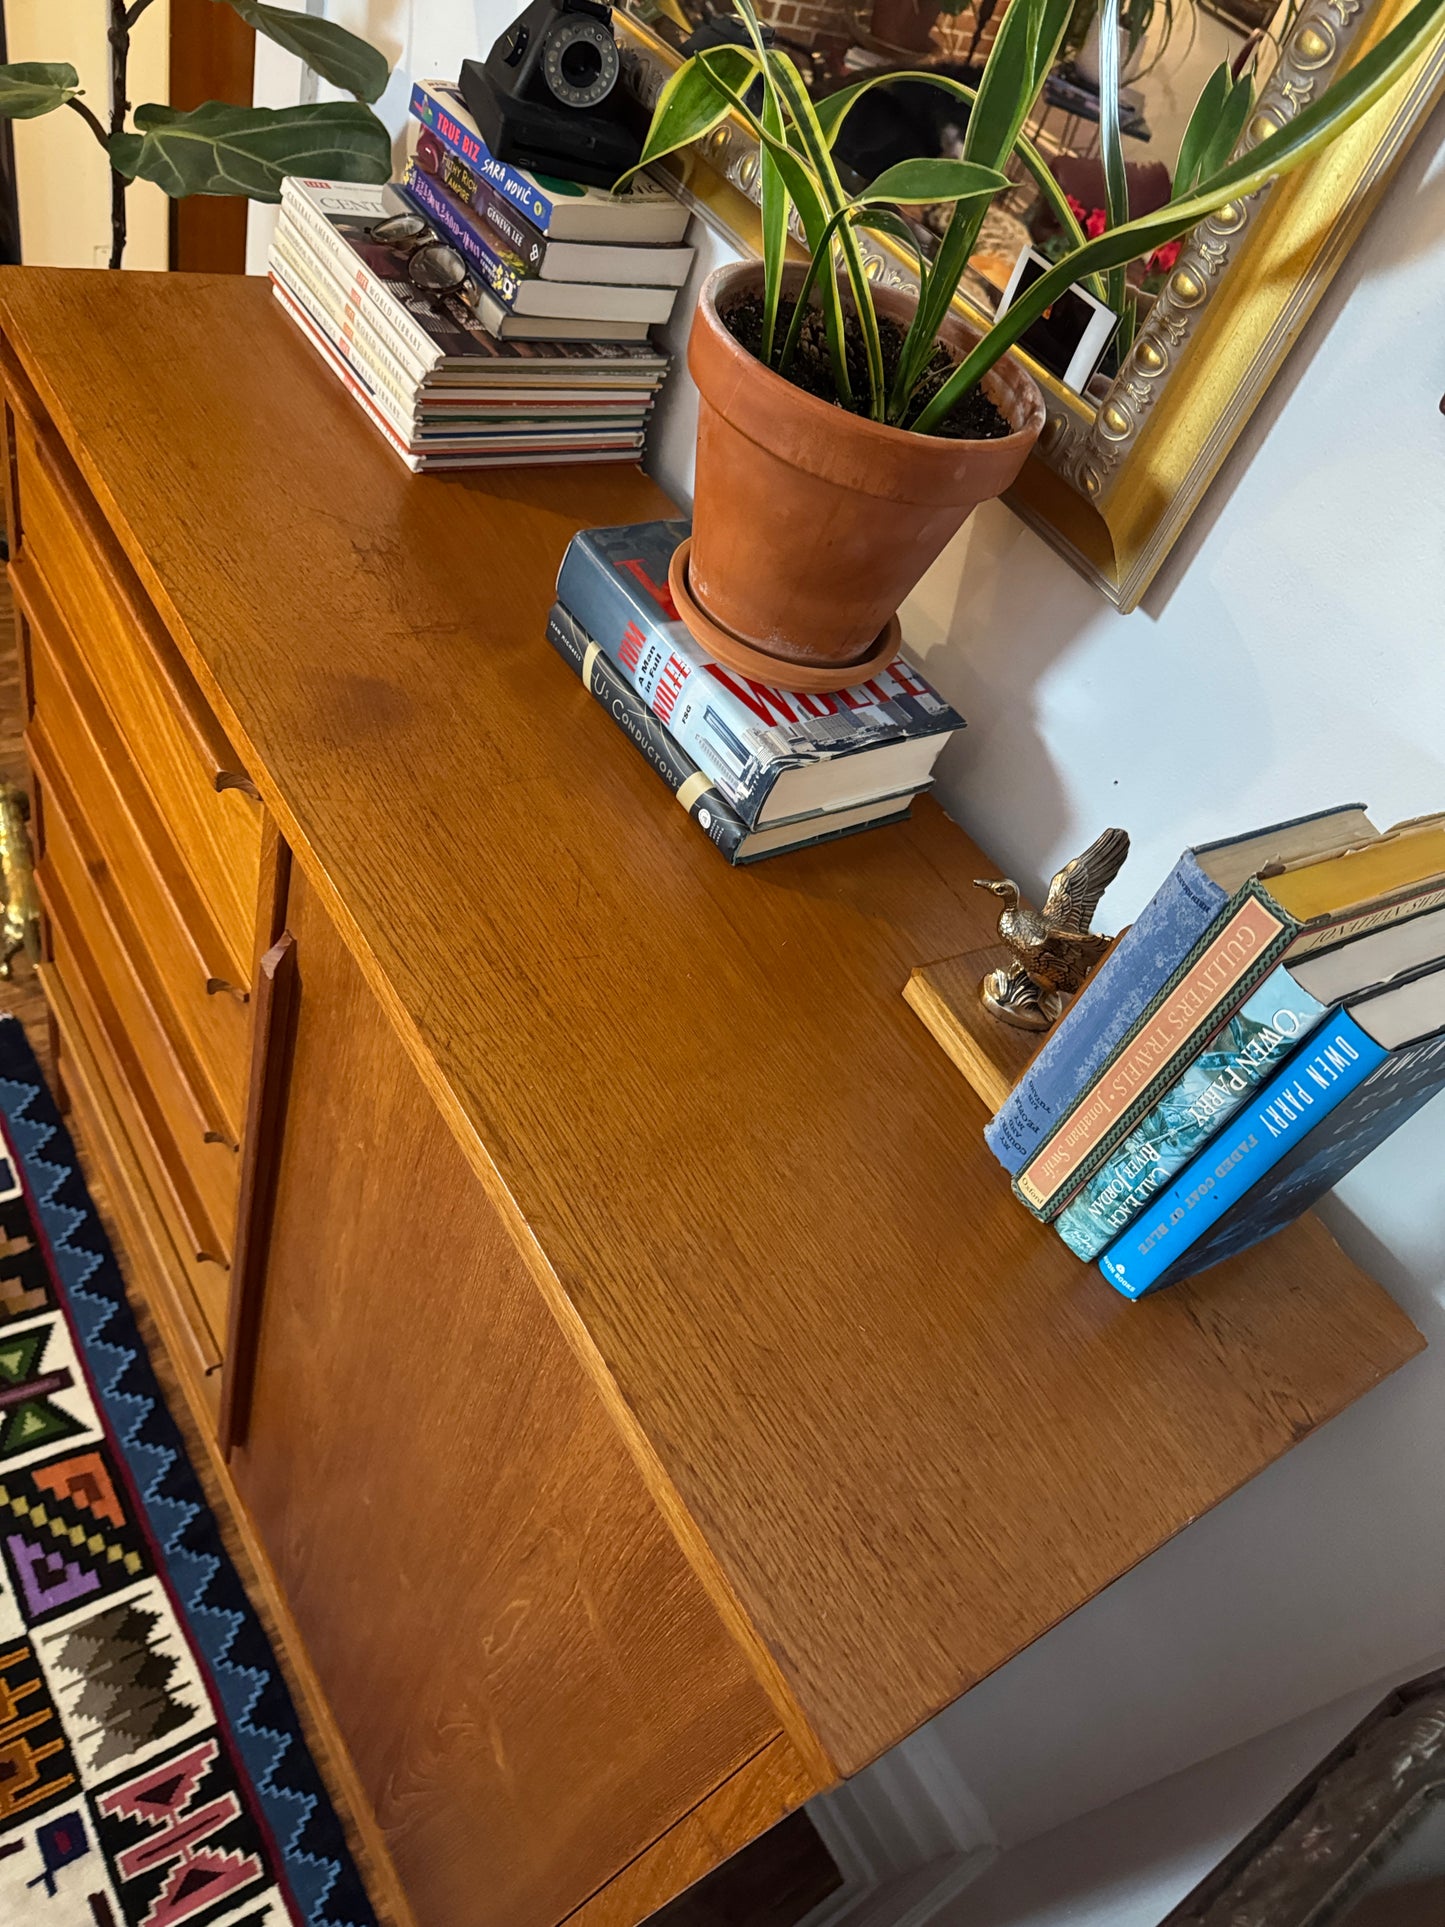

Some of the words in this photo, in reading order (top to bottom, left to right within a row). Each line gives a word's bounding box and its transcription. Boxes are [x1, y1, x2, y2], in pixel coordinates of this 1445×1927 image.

[437, 113, 460, 146] TRUE
[462, 135, 480, 163] BIZ
[442, 151, 462, 177] FILTHY
[462, 169, 479, 195] RICH
[444, 170, 471, 204] VAMPIRE
[481, 158, 506, 182] SARA
[504, 179, 531, 205] NOVIĆ
[286, 191, 311, 221] CENTRAL
[314, 221, 339, 257] AMERICA
[487, 207, 511, 237] GENEVA
[511, 232, 524, 248] LEE
[369, 286, 392, 317] WORLD
[395, 314, 423, 351] LIBRARY
[356, 319, 376, 349] WORLD
[378, 346, 402, 382] LIBRARY
[352, 353, 373, 383] WORLD
[375, 381, 400, 419] LIBRARY
[550, 620, 561, 636] SEAN
[561, 634, 582, 664] MICHAELS
[618, 618, 647, 674] TOM
[637, 676, 645, 688] A
[641, 644, 657, 675] Man
[644, 681, 652, 694] in
[649, 652, 662, 679] Full
[652, 651, 692, 726] WOLFE
[681, 703, 692, 725] FSG
[612, 698, 678, 788] CONDUCTORS
[1167, 925, 1257, 1031] GULLIVER'S
[1112, 1026, 1175, 1097] TRAVELS
[1235, 1009, 1300, 1076] OWEN
[1305, 1035, 1360, 1090] OWEN
[1014, 1096, 1041, 1134] PEOPLE
[1028, 1094, 1040, 1111] LIN
[1029, 1080, 1052, 1114] YUTANG
[1064, 1089, 1113, 1149] Jonathan
[1187, 1066, 1248, 1128] PARRY
[1259, 1080, 1314, 1138] PARRY
[1000, 1116, 1027, 1156] COUNTRY
[1000, 1136, 1012, 1152] MY
[1008, 1119, 1022, 1138] AND
[1014, 1115, 1026, 1130] MY
[1041, 1149, 1071, 1179] Swift
[1123, 1142, 1162, 1181] RIVER
[1214, 1133, 1259, 1178] FADED
[1022, 1177, 1044, 1205] Oxford
[1088, 1166, 1135, 1220] JORDAN
[1134, 1167, 1172, 1198] CALL
[1184, 1176, 1216, 1210] COAT
[1107, 1193, 1145, 1229] EACH
[1169, 1207, 1186, 1226] OF
[1137, 1222, 1169, 1256] BLUE
[1103, 1255, 1117, 1275] AVON
[1114, 1271, 1136, 1294] BOOKS
